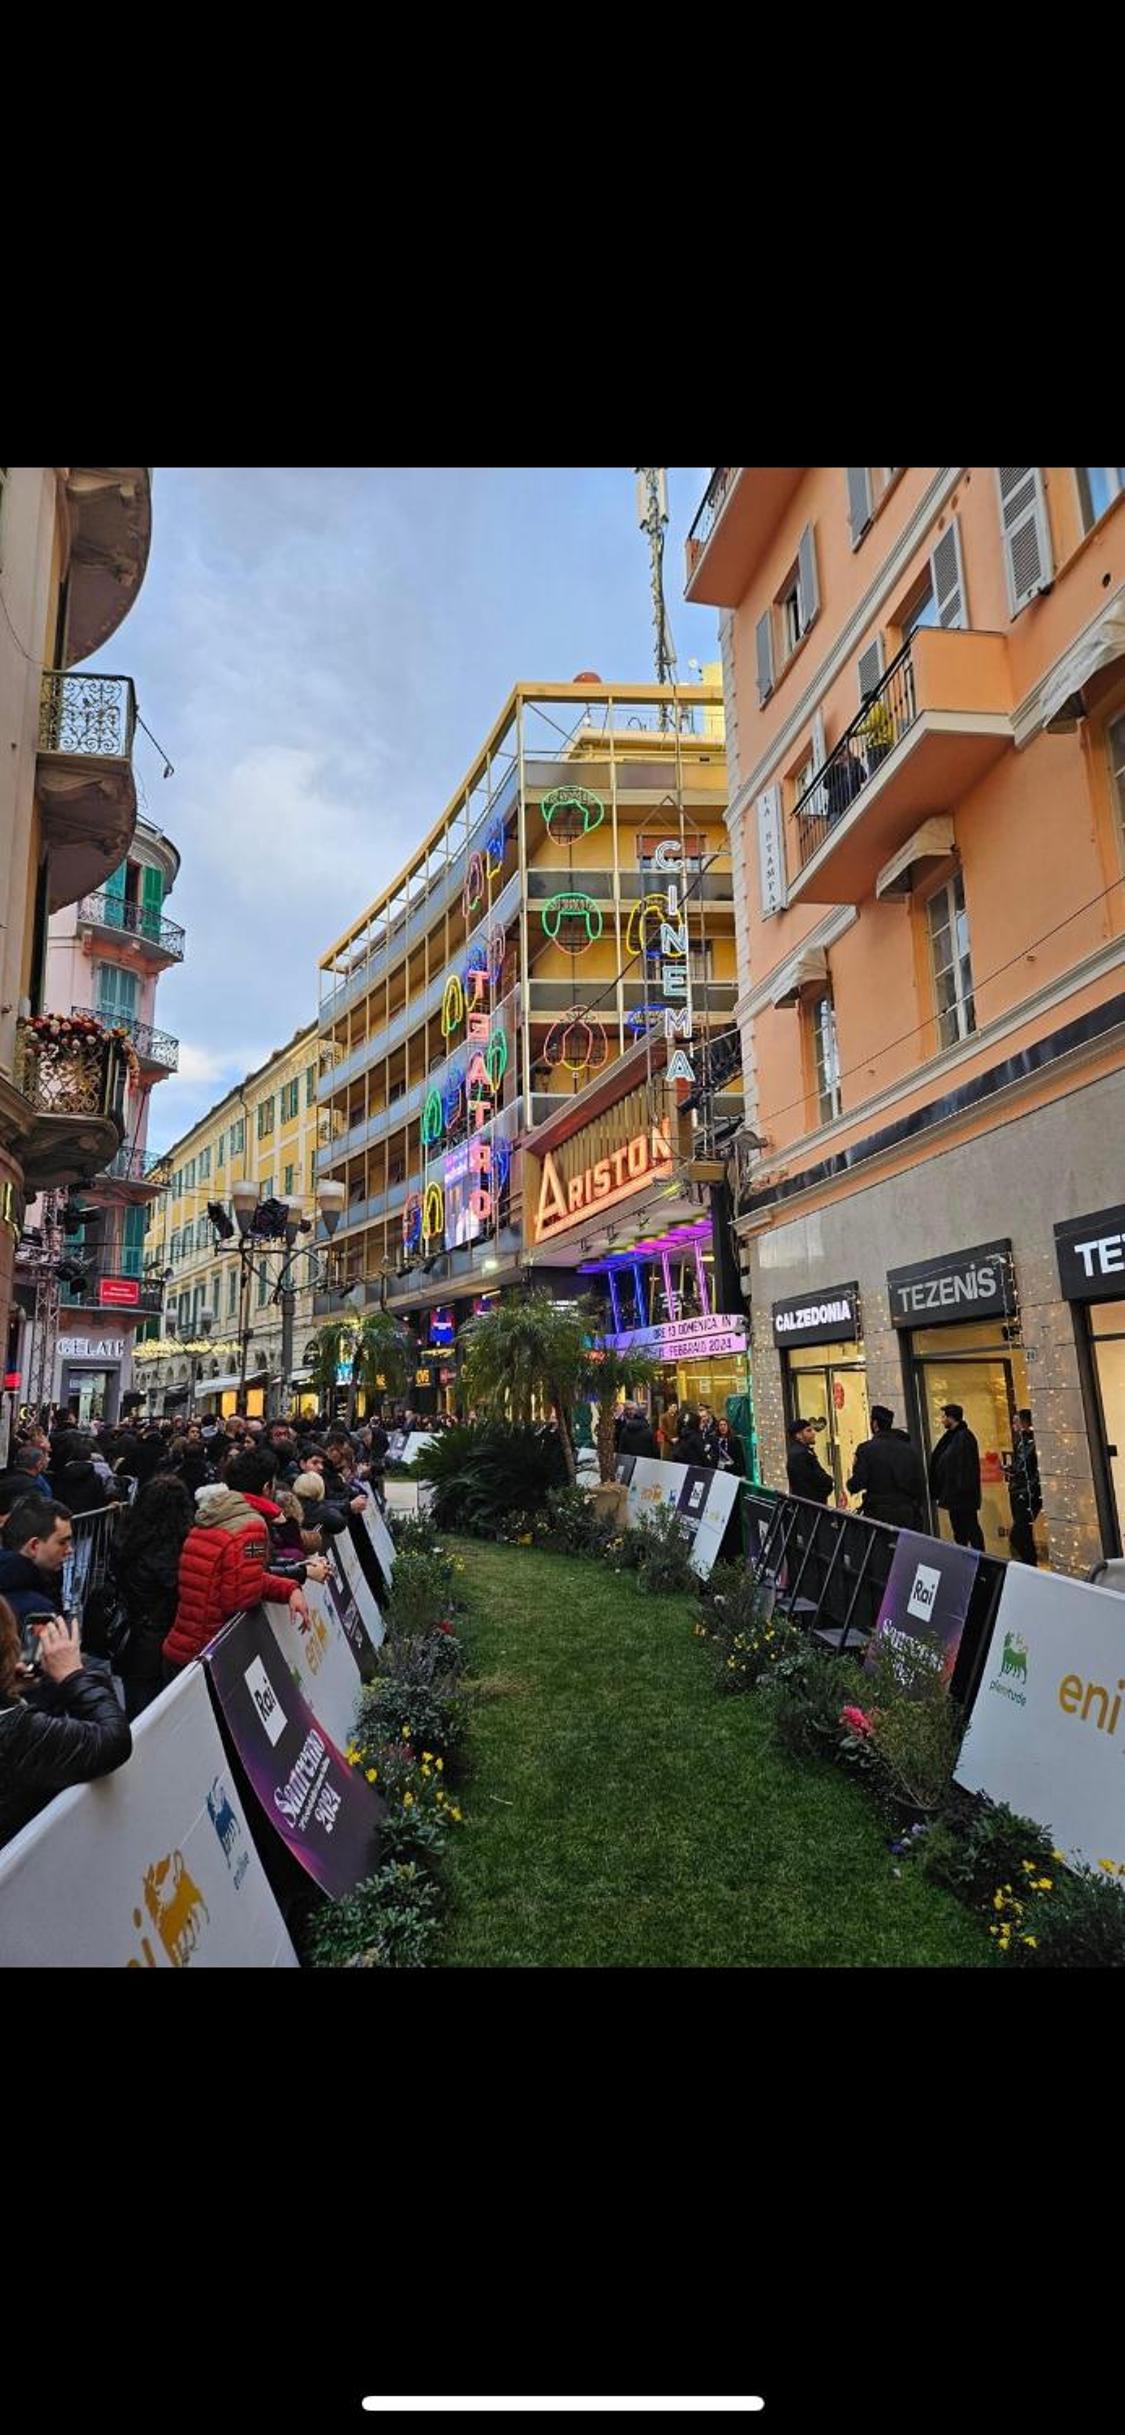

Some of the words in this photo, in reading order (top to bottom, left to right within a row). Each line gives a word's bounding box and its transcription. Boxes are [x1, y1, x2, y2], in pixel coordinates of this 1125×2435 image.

[655, 839, 696, 1082] CINEMA
[534, 1116, 673, 1243] ARISTON
[1074, 1233, 1125, 1278] TE
[897, 1264, 998, 1313] TEZENIS
[678, 1317, 718, 1335] DOMENICA
[775, 1300, 851, 1332] CALZEDONIA
[913, 1579, 936, 1607] Rai
[254, 1676, 277, 1722] Rai
[1058, 1673, 1125, 1736] eni
[274, 1728, 325, 1828] Sanremo
